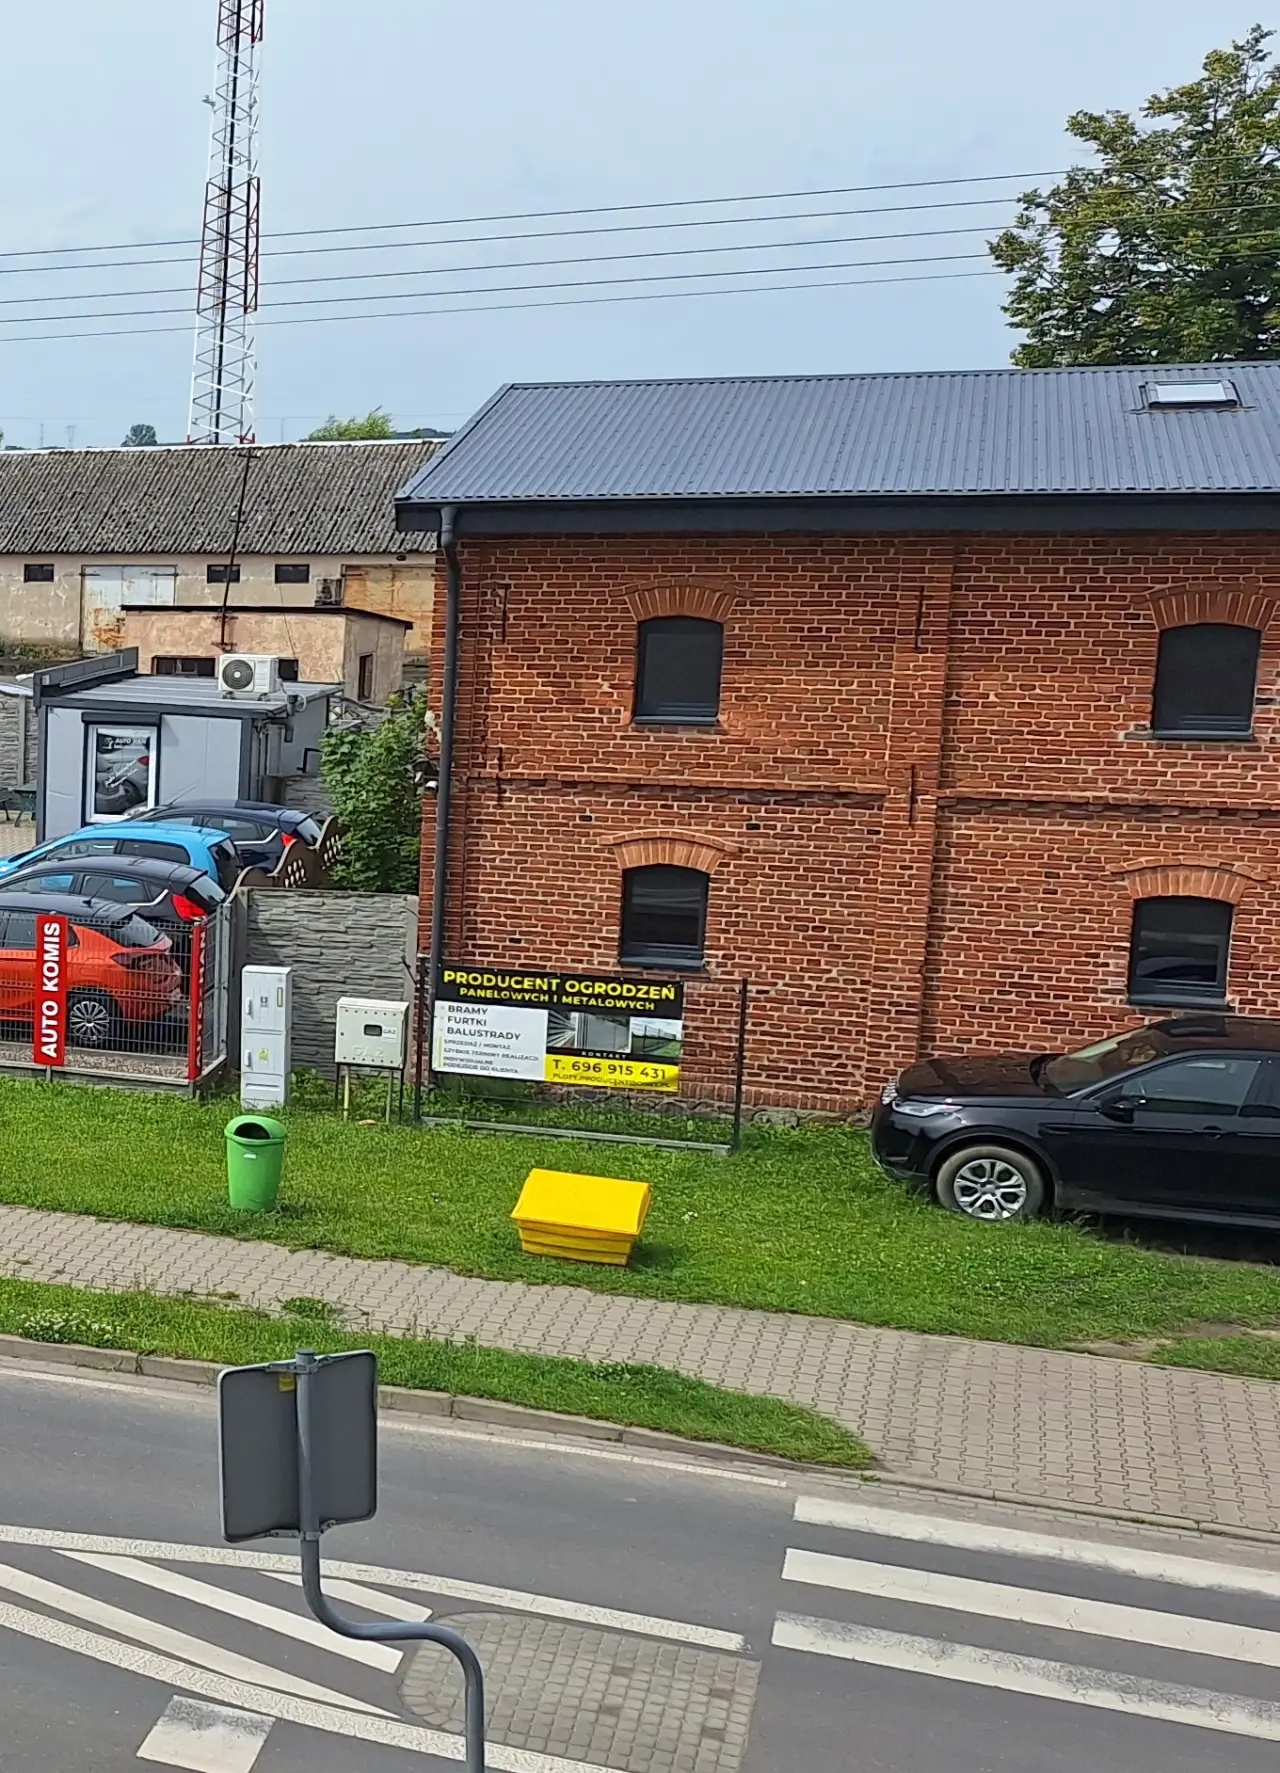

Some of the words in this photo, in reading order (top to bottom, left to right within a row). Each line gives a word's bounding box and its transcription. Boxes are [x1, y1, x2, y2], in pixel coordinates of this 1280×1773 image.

[43, 922, 61, 992] KOMIS
[443, 970, 560, 992] PRODUCENT
[565, 979, 676, 1000] OGRODZEŃ
[459, 987, 549, 1003] PANELOWYCH
[553, 995, 558, 1003] I
[561, 995, 655, 1011] METALOWYCH
[448, 1005, 488, 1015] BRAMY
[41, 1000, 60, 1059] AUTO
[447, 1015, 487, 1027] FURTKI
[447, 1026, 521, 1040] BALUSTRADY
[581, 1051, 628, 1059] KONTAKT
[552, 1059, 566, 1070] T.
[571, 1061, 602, 1073] 696
[607, 1064, 634, 1076] 915
[640, 1067, 666, 1080] 431
